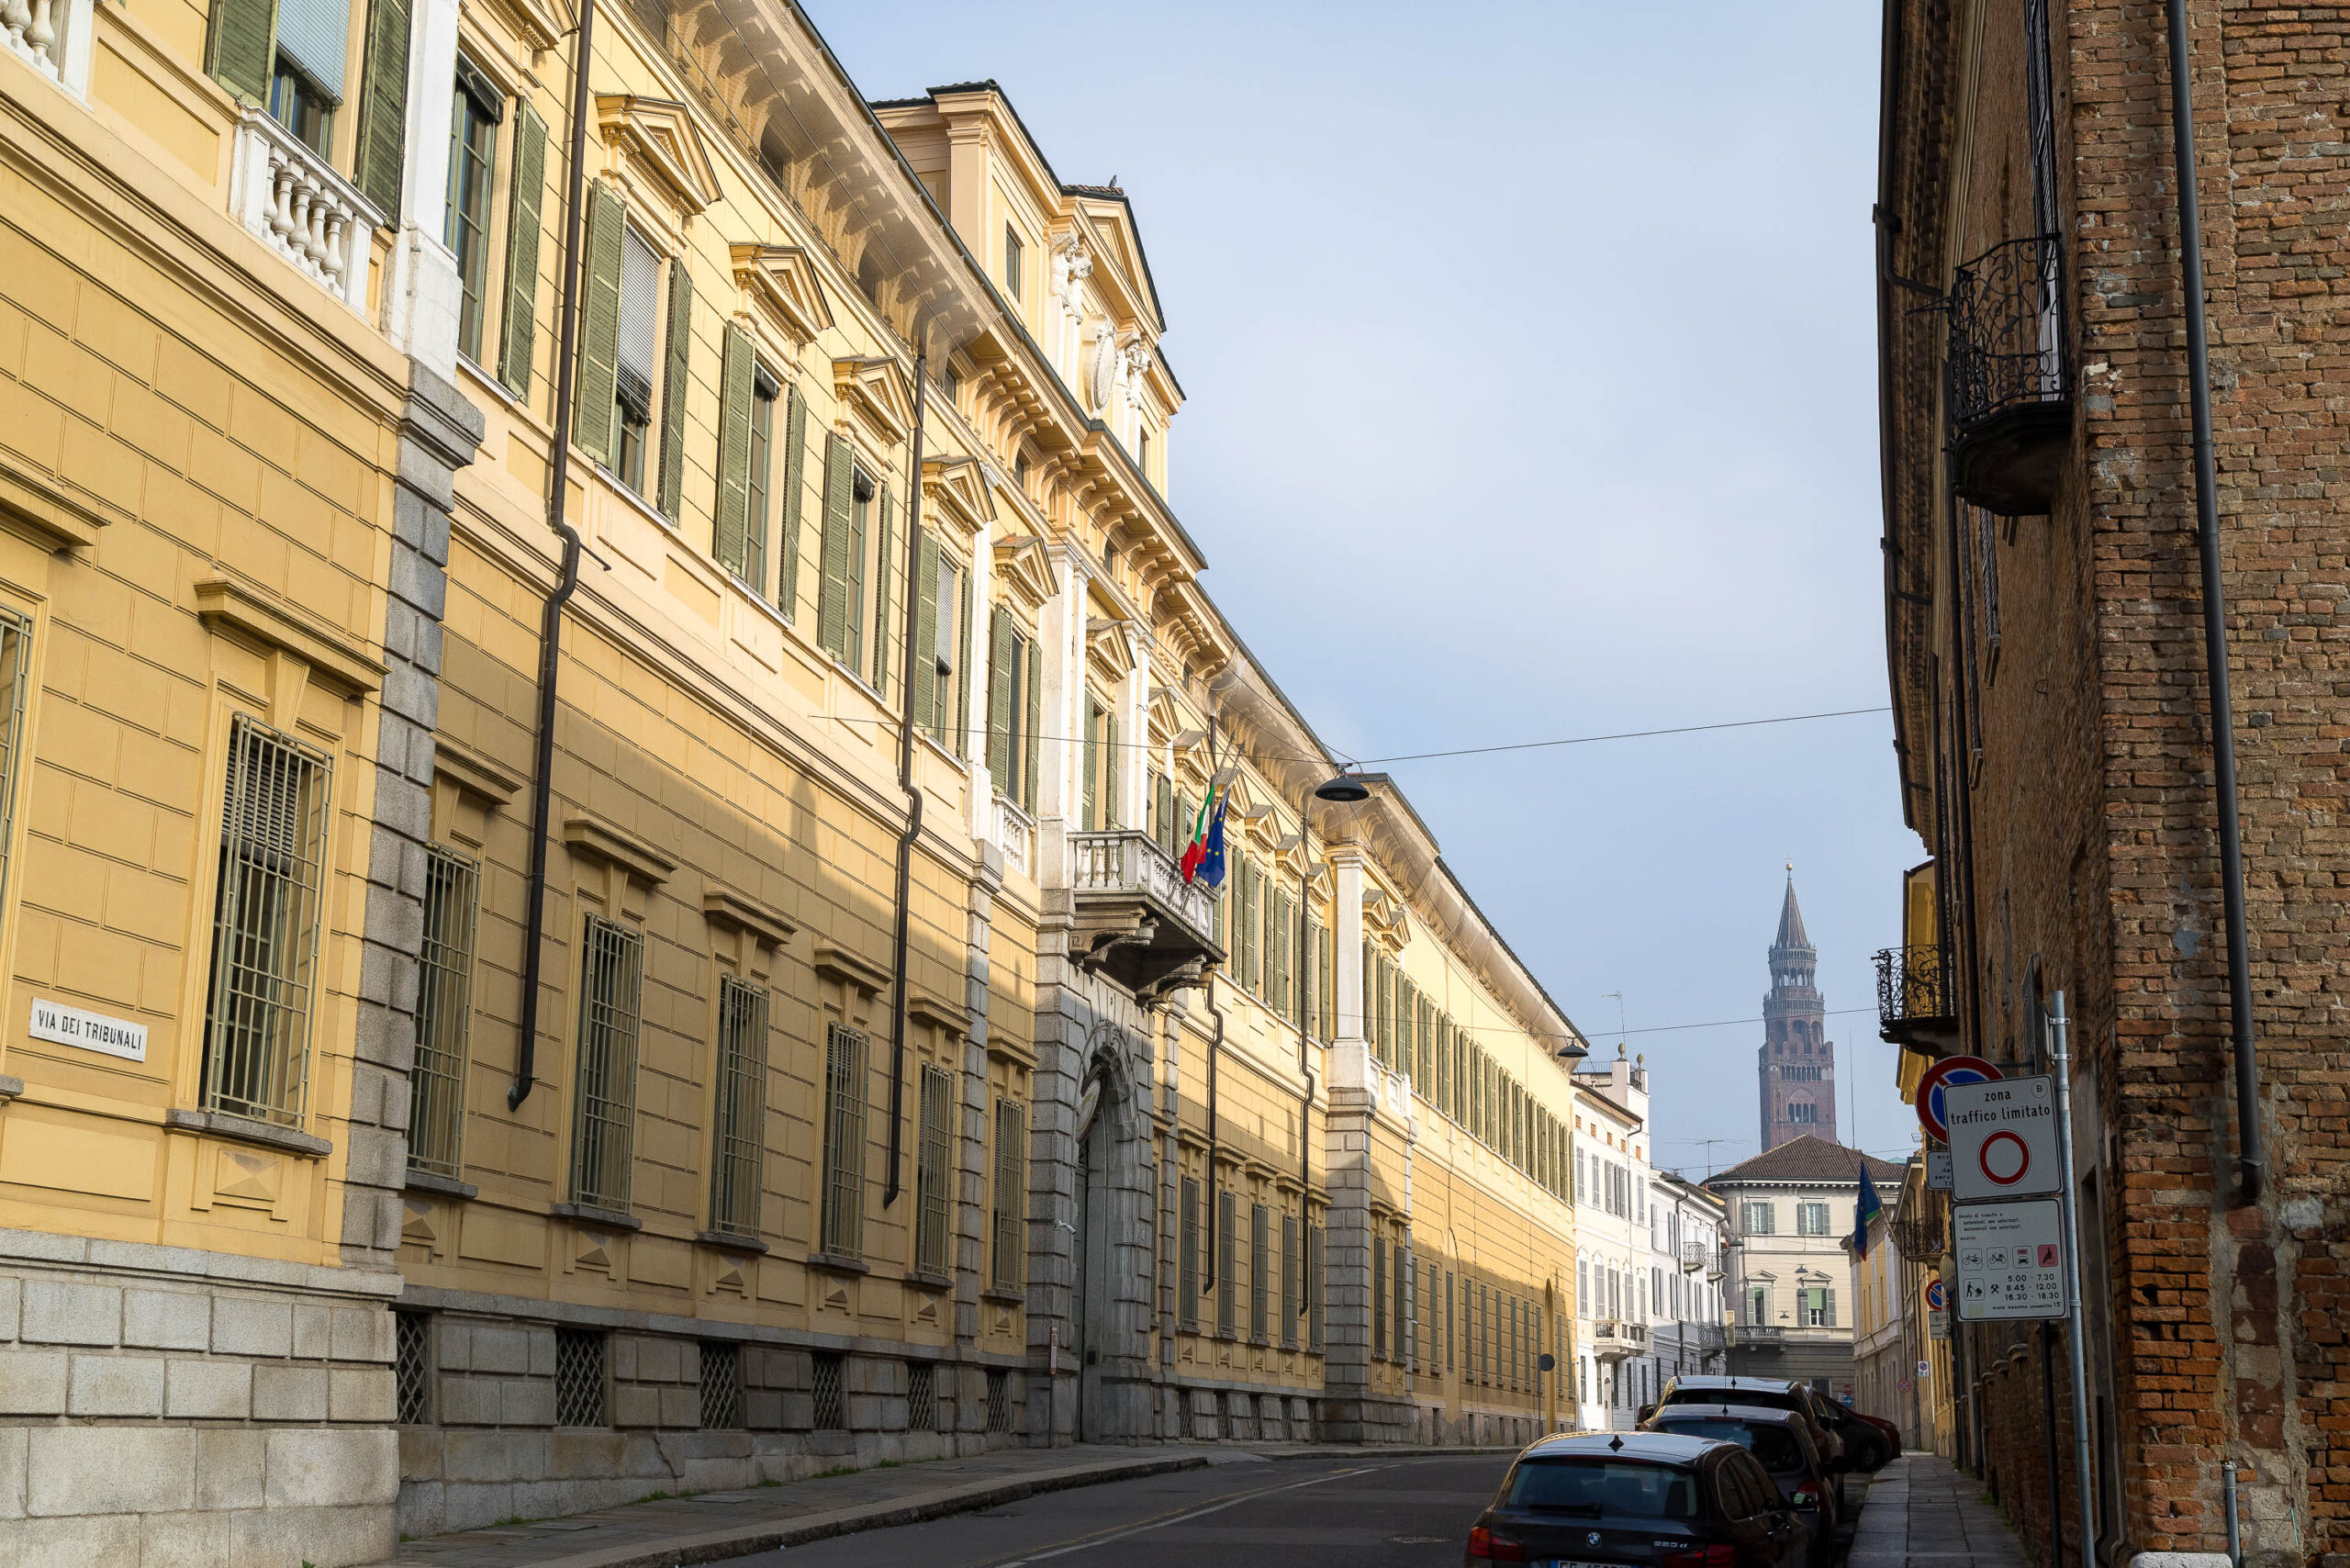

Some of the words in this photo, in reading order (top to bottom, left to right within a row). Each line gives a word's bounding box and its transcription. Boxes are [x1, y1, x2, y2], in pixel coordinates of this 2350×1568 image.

[39, 1010, 56, 1030] VIA
[62, 1015, 80, 1036] DEI
[85, 1021, 141, 1050] TRIBUNALI
[1985, 1090, 2011, 1102] zona
[1951, 1110, 1997, 1125] traffico
[2001, 1103, 2050, 1120] limitato
[2008, 1274, 2027, 1282] 5.00
[2036, 1282, 2057, 1291] 12.00
[2038, 1292, 2060, 1300] 18.30
